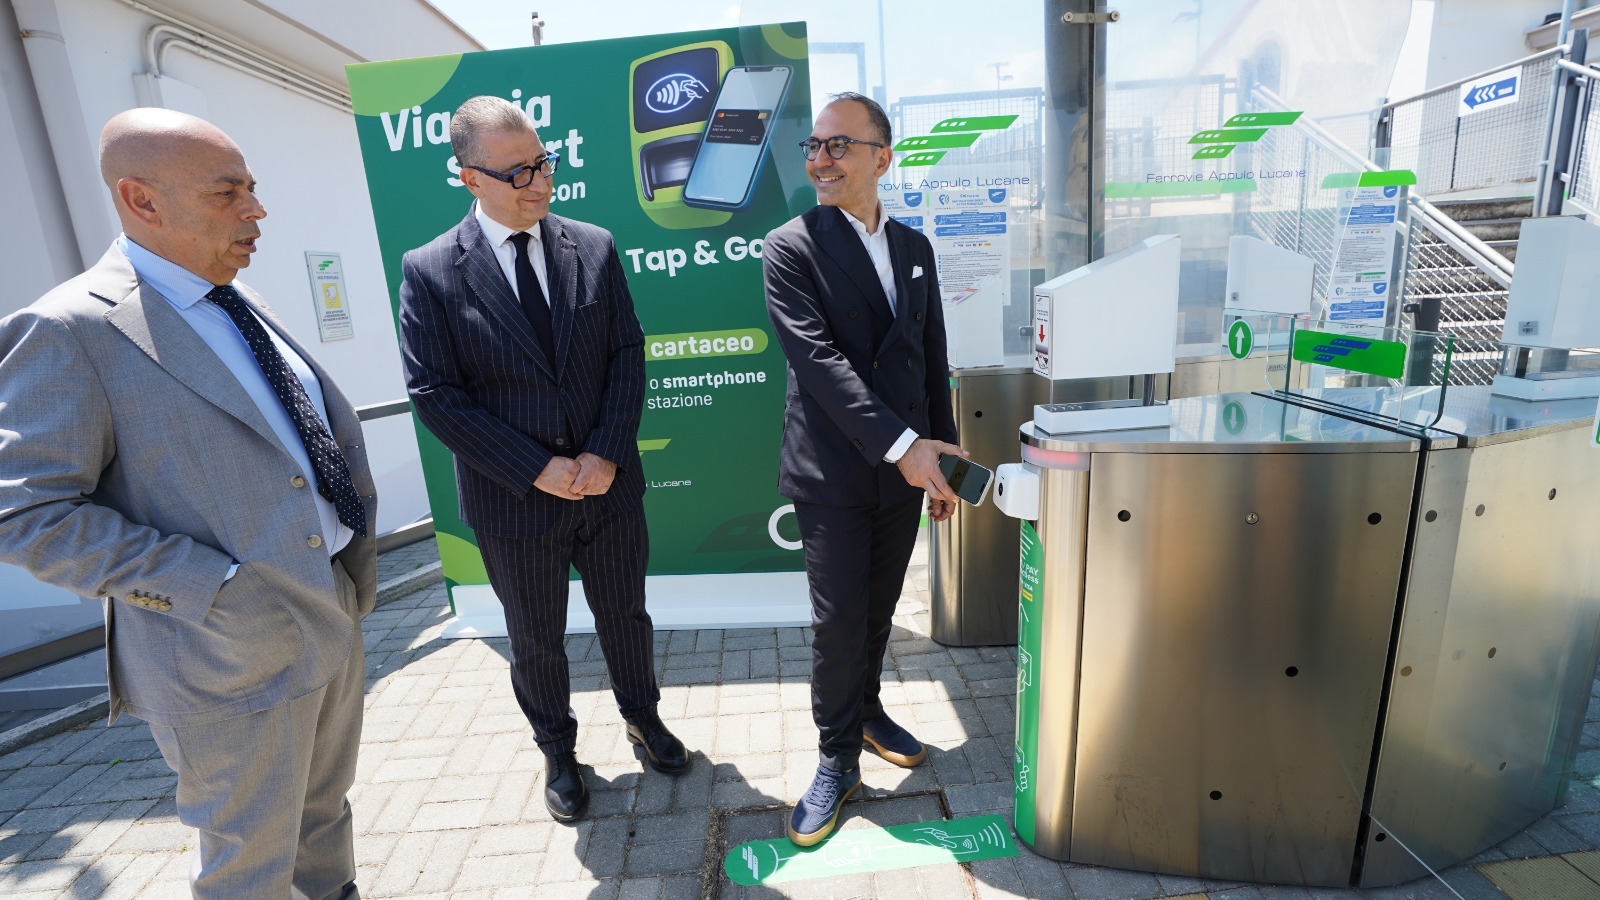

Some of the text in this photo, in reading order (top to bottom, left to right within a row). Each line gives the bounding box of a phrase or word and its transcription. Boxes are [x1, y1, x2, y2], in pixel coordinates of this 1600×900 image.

[380, 88, 551, 152] Viaia
[446, 128, 584, 187] srt
[878, 176, 1030, 191] rovie Appulo Lucane
[1146, 169, 1307, 184] Ferrovie Appulo Lucane
[625, 236, 764, 278] Tap & Go
[650, 335, 754, 358] cartaceo
[649, 370, 767, 390] o smartphone
[647, 393, 713, 410] stazione
[651, 479, 692, 488] Lucane
[1025, 564, 1039, 576] PAY
